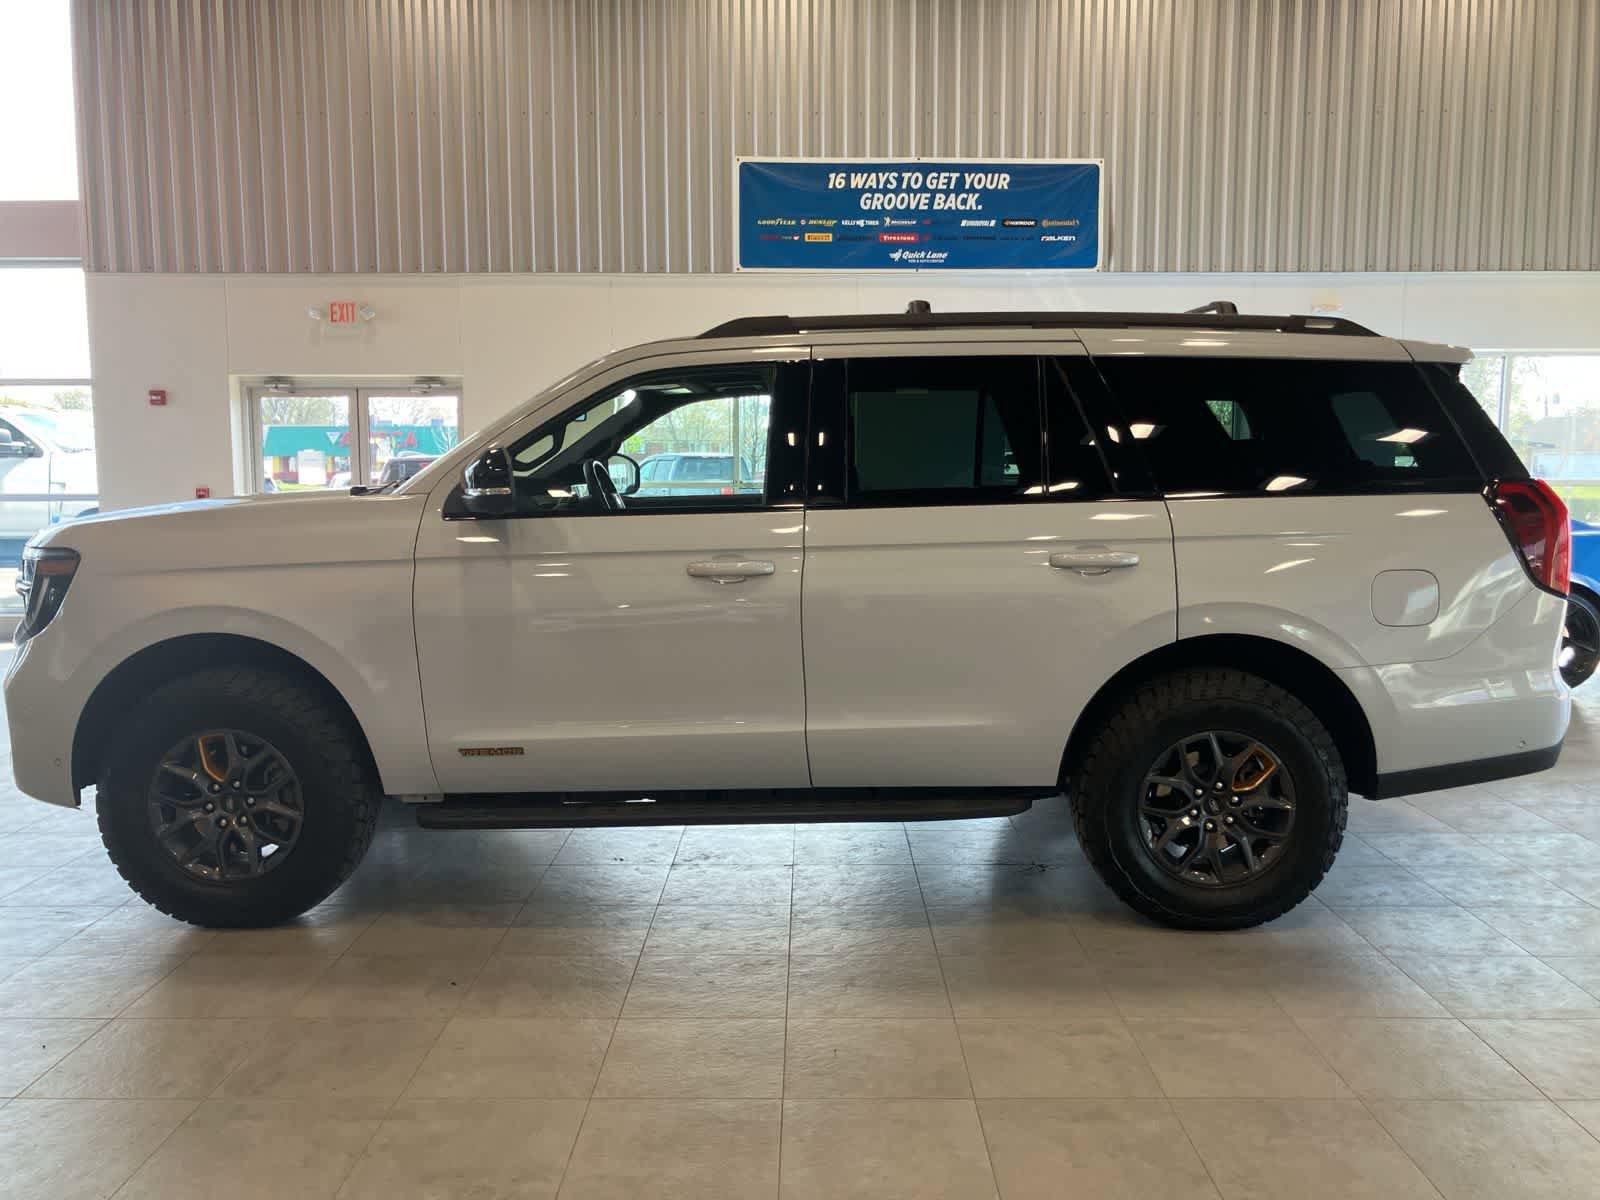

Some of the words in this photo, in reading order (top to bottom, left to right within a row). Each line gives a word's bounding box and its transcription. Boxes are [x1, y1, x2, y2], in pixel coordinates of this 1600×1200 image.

[828, 173, 846, 190] 16
[850, 173, 898, 190] WAYS
[901, 173, 923, 190] TO
[926, 173, 960, 190] GET
[964, 172, 1010, 190] YOUR
[859, 193, 930, 211] GROOVE
[932, 193, 983, 211] BACK.
[883, 233, 915, 241] Firestone
[902, 250, 926, 260] Quick
[926, 250, 948, 259] Lane
[329, 302, 356, 323] EXIT
